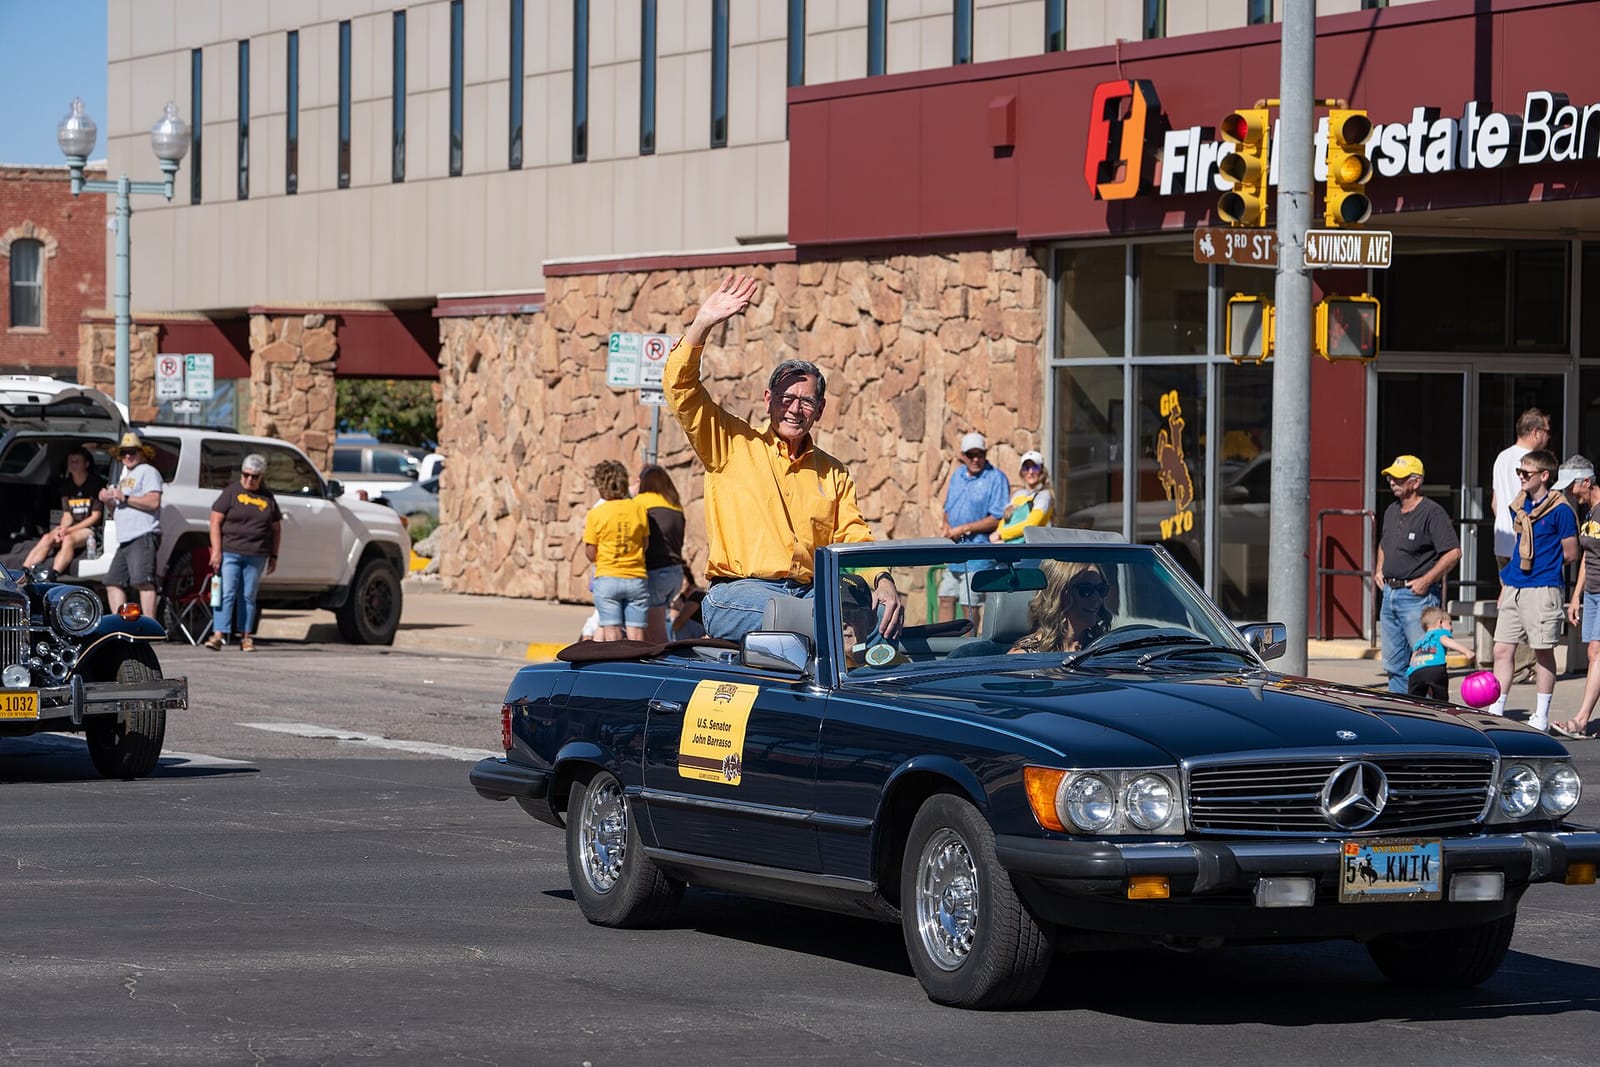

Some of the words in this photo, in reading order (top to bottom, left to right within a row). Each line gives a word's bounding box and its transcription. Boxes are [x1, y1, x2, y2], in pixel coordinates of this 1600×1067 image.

[1160, 126, 1237, 195] Fir
[1269, 101, 1511, 186] Itrstate
[1225, 234, 1248, 259] 3RD
[1252, 235, 1272, 260] ST
[1318, 235, 1362, 262] IVINSON
[1367, 236, 1388, 263] AVE
[1159, 510, 1193, 540] WYO
[6, 696, 33, 711] 1032
[697, 717, 708, 729] U.S.
[709, 719, 732, 732] Senator
[692, 733, 706, 745] John
[707, 735, 732, 748] Barrasso
[1346, 856, 1356, 883] 5
[1386, 854, 1431, 883] KWIK
